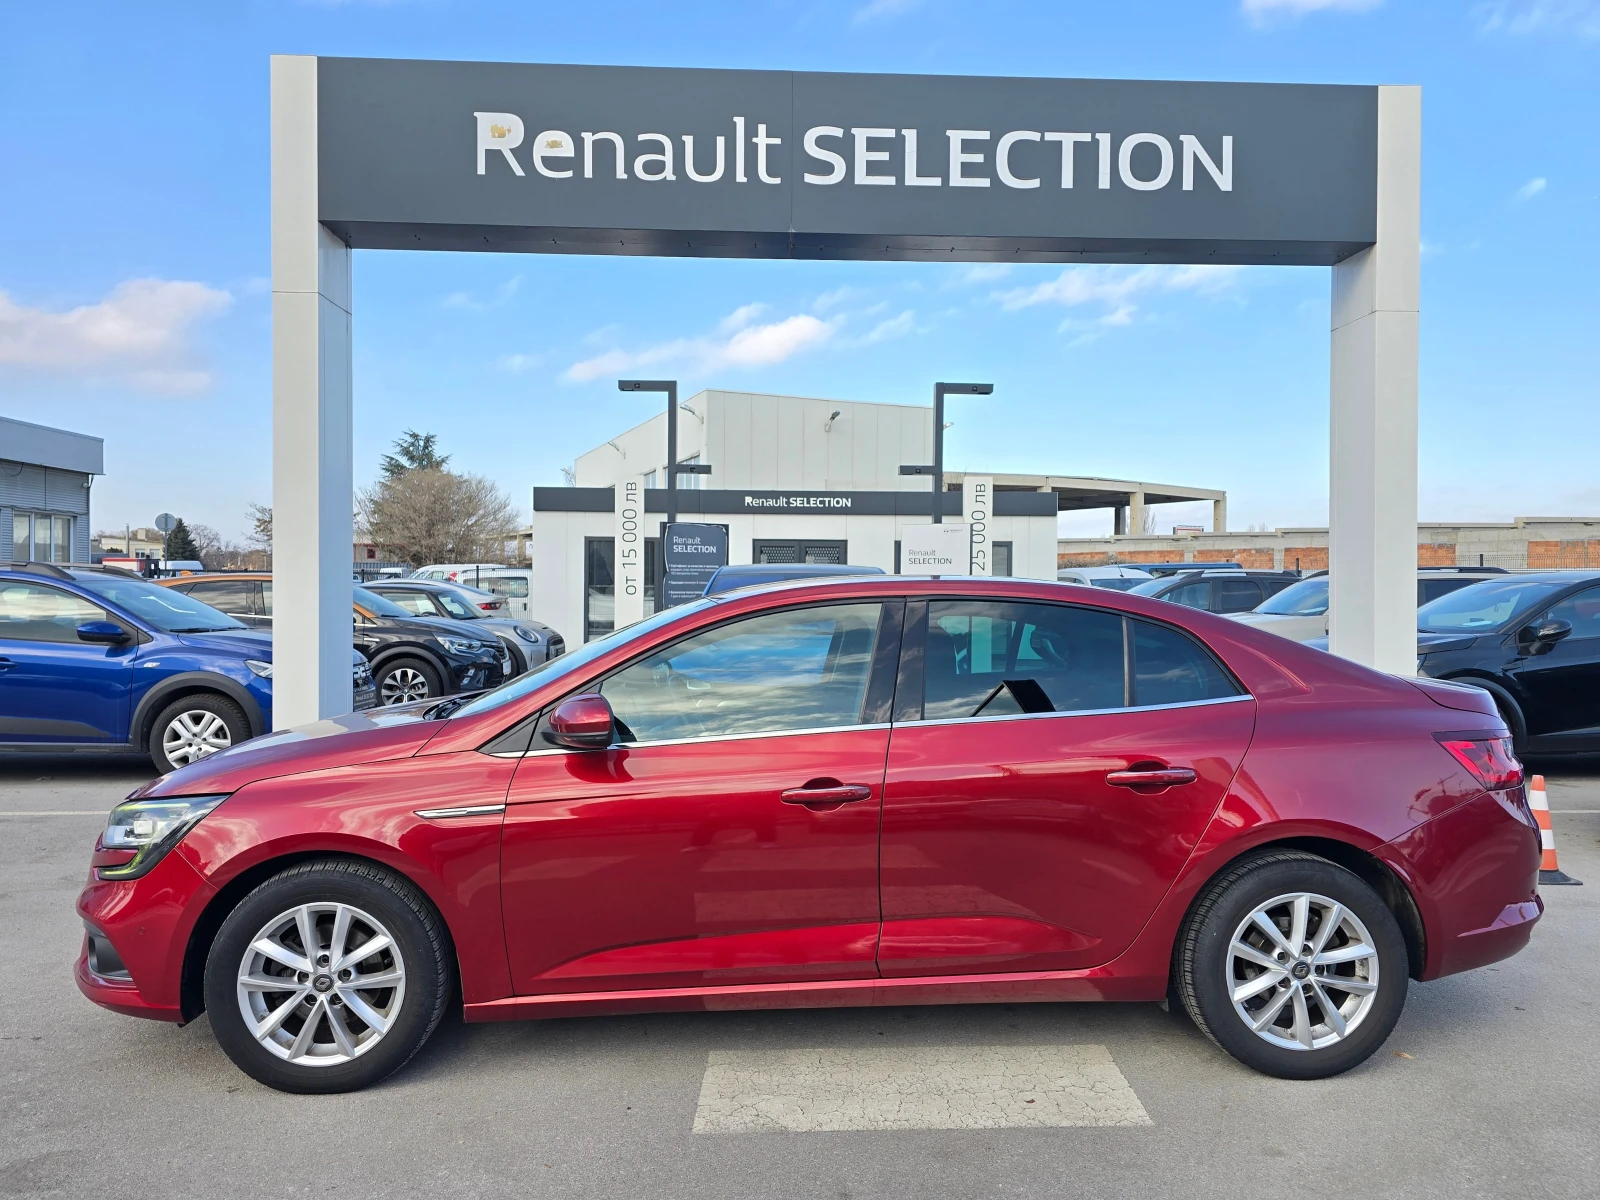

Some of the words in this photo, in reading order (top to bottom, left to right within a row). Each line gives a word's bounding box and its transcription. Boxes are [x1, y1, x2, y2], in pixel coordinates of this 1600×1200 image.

[473, 111, 782, 185] Renault
[802, 125, 1234, 193] SELECTION
[744, 496, 788, 507] Renault
[789, 497, 852, 508] SELECTION
[622, 508, 637, 543] 000
[971, 510, 986, 544] 000
[673, 536, 701, 545] Renault
[673, 545, 717, 553] SELECTION
[908, 549, 936, 557] Renault
[622, 548, 637, 569] 15
[908, 557, 952, 565] SELECTION
[972, 549, 986, 571] 25
